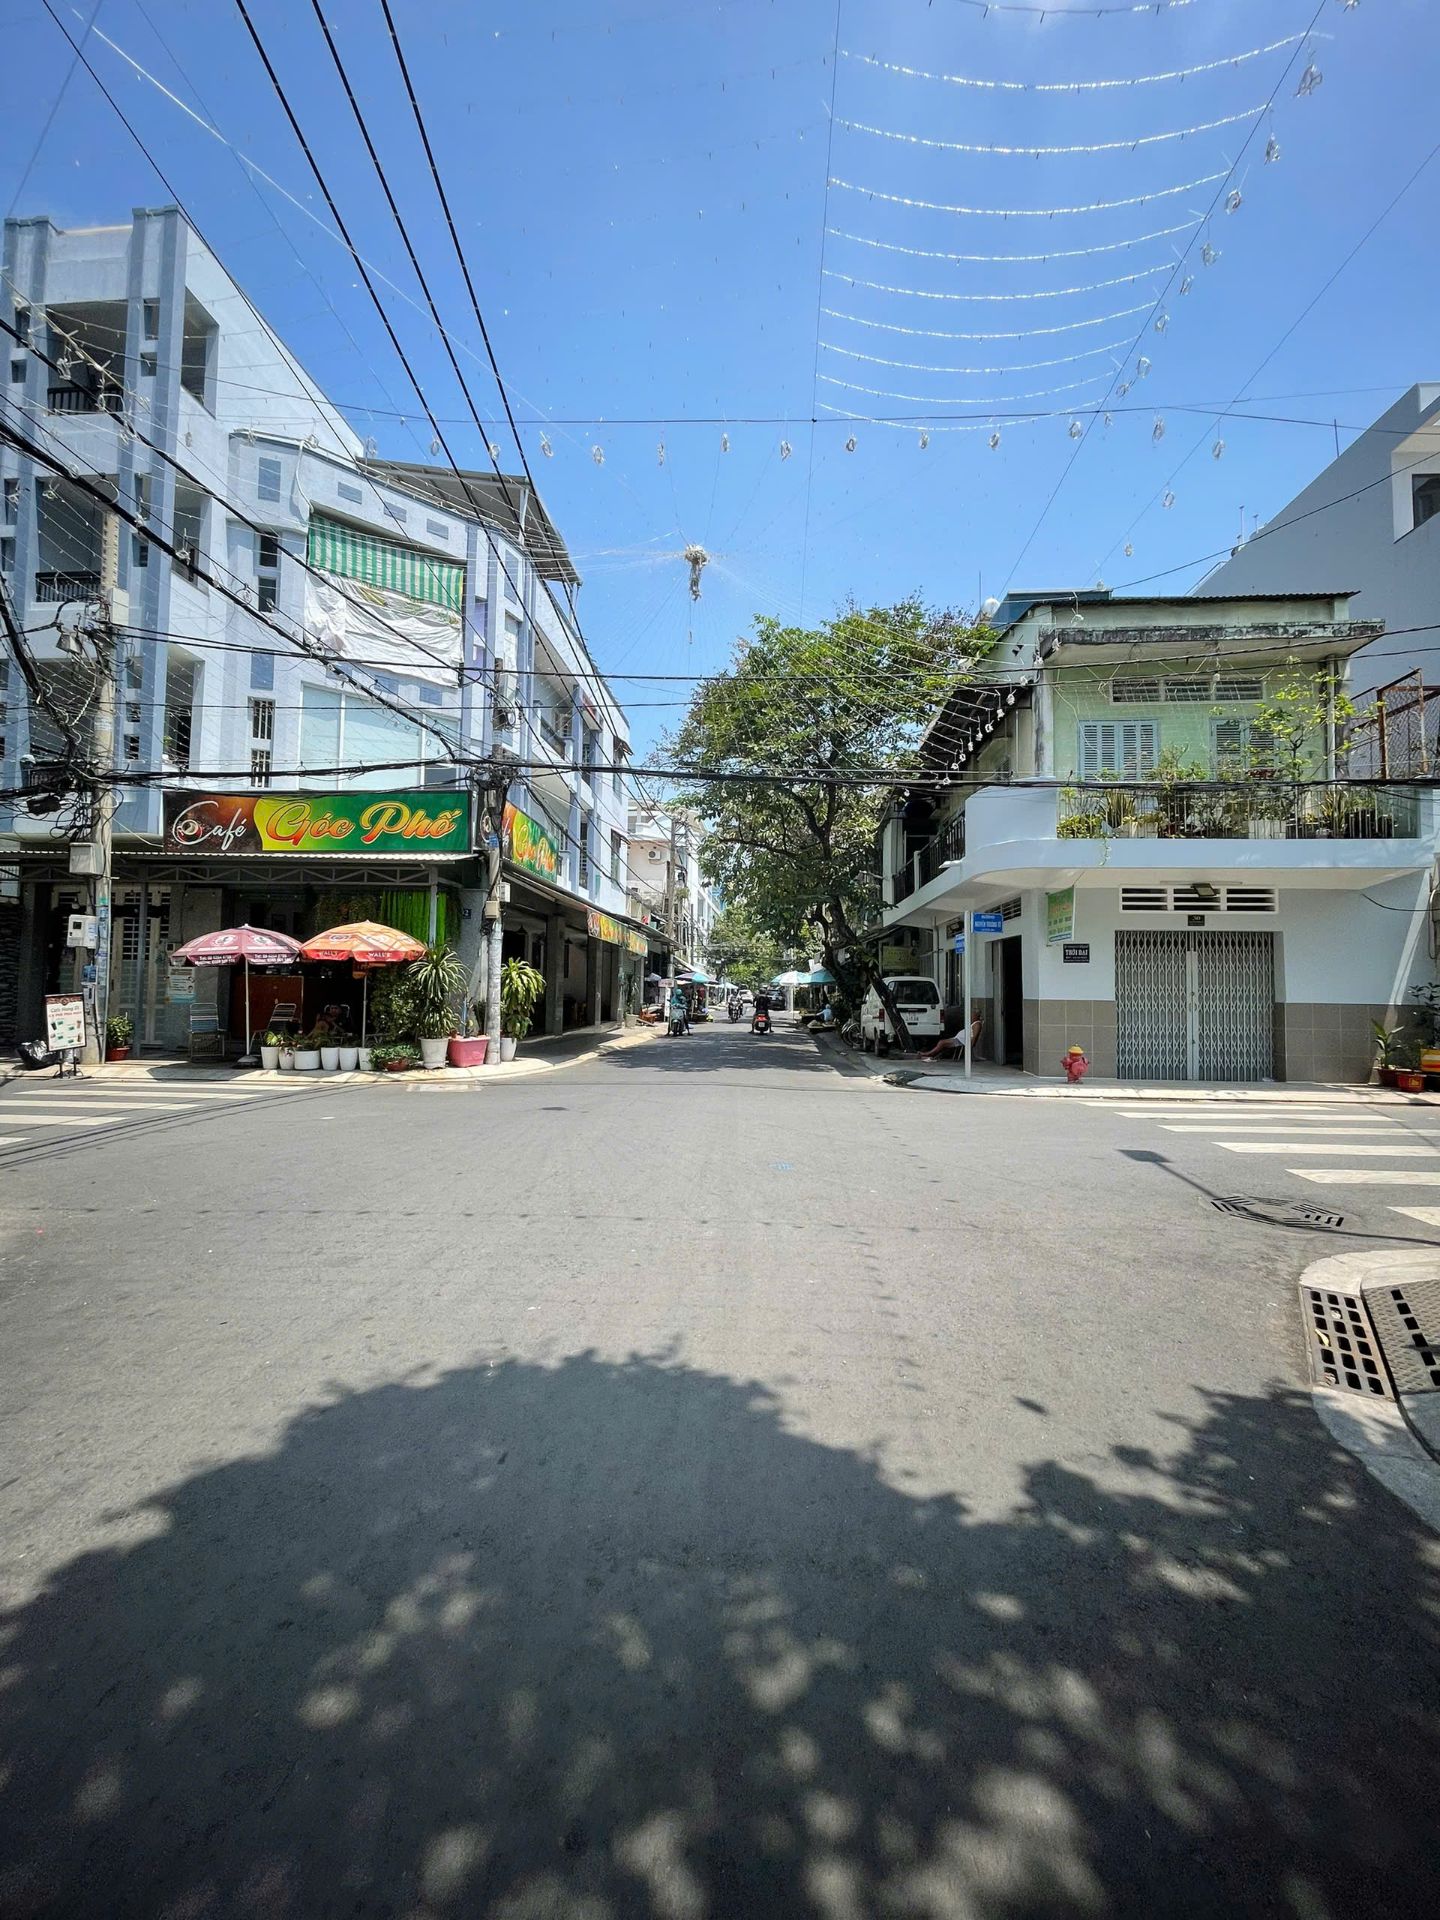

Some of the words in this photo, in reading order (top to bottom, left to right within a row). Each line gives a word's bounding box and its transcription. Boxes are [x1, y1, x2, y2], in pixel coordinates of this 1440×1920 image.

[173, 800, 247, 850] Café
[267, 800, 354, 847] Góc
[360, 801, 463, 843] Phố
